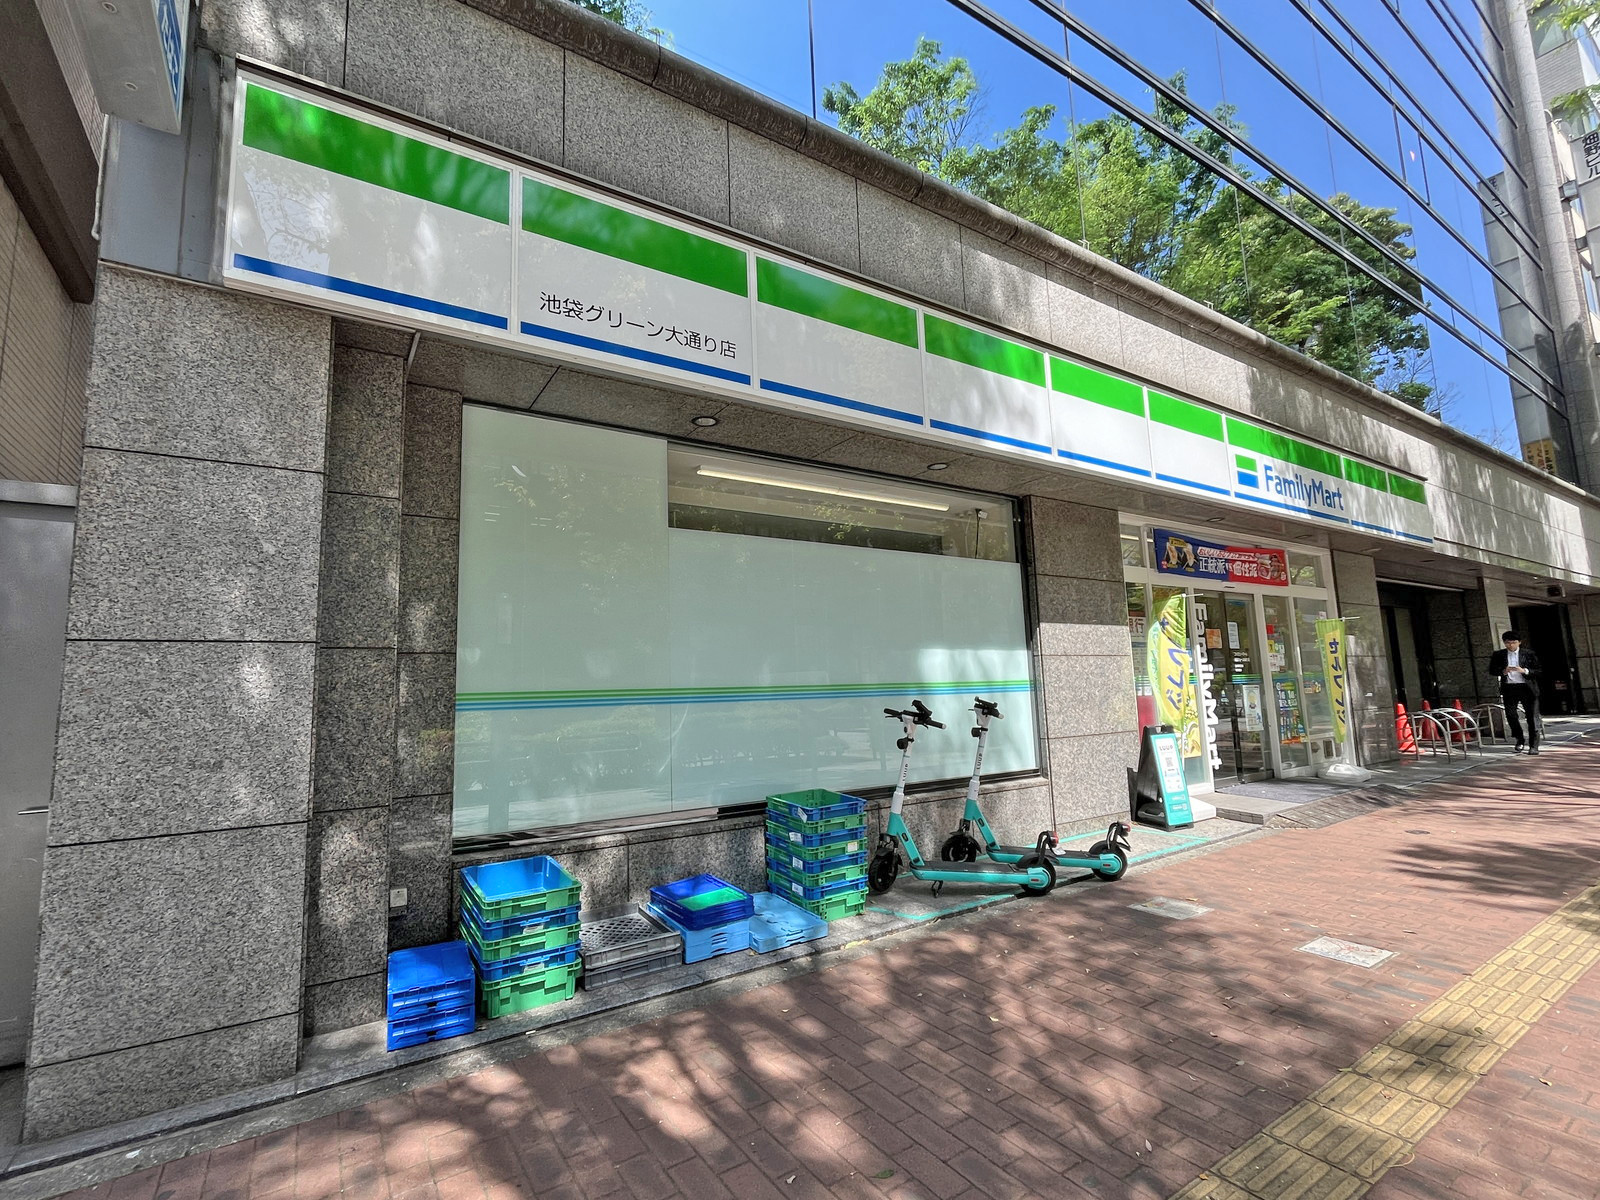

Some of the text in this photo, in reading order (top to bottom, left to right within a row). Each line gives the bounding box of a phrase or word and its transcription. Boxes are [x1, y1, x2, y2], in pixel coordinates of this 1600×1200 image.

[539, 291, 737, 359] 池袋グリーン大通り店
[1264, 464, 1344, 511] FamilyMart
